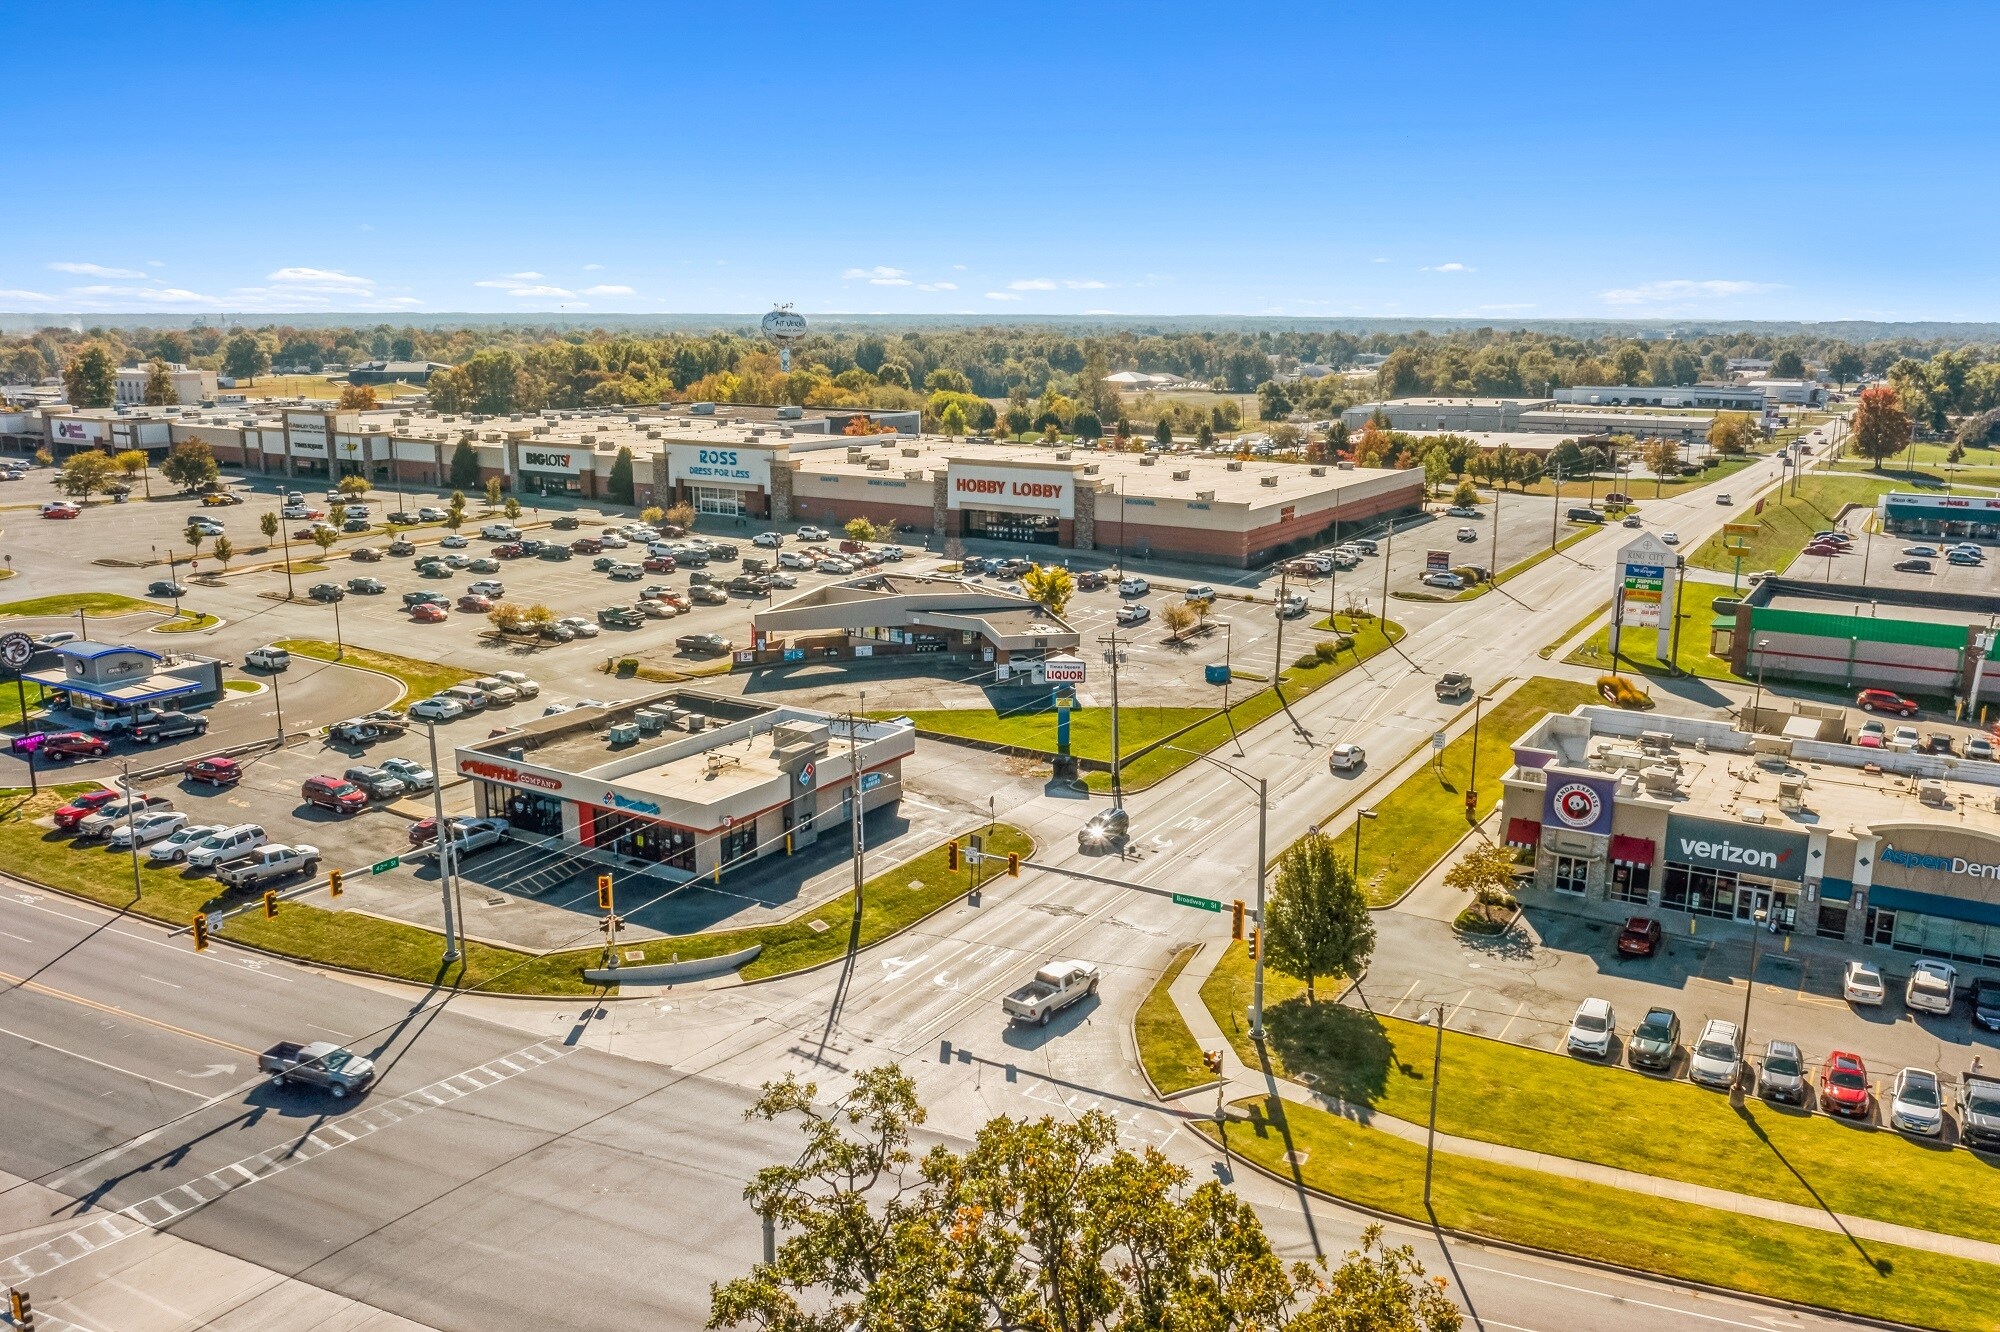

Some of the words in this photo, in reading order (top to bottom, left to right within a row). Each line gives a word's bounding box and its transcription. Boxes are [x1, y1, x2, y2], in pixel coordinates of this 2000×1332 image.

[699, 450, 738, 466] ROSS
[689, 466, 712, 476] DRESS
[714, 468, 730, 477] FOR
[731, 470, 750, 479] LESS
[956, 478, 1006, 494] HOBBY
[1012, 481, 1063, 499] LOBBY
[1627, 551, 1645, 560] KING
[1640, 566, 1657, 577] Kroger
[1637, 578, 1662, 586] SUPPLIES
[1046, 670, 1083, 680] LIQUOR
[16, 735, 45, 746] SHAKES
[520, 775, 557, 789] COMPANY
[1556, 785, 1575, 803] PANDA
[1576, 785, 1599, 808] EXPRESS
[1680, 838, 1777, 869] verizon
[1880, 843, 1952, 873] Aspen
[1176, 894, 1206, 907] Broadway
